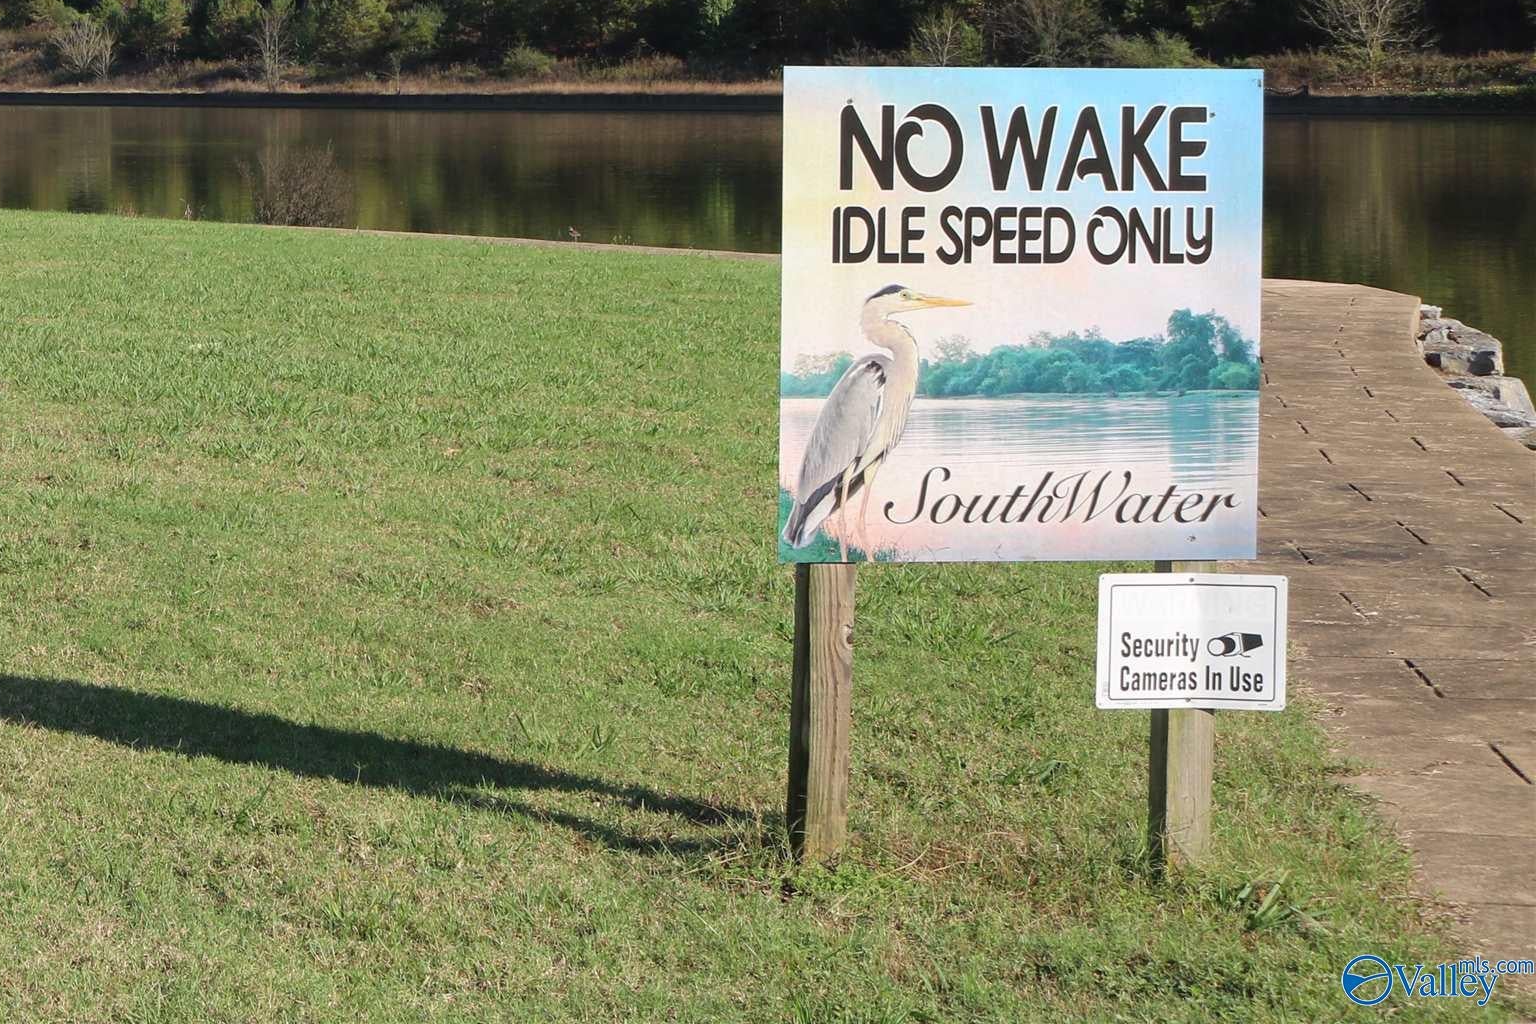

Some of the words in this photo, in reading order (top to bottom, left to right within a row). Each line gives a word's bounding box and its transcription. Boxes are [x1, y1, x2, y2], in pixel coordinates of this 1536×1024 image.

[839, 104, 964, 192] NO
[981, 106, 1208, 191] WAKE
[832, 207, 925, 264] IDLE
[936, 206, 1076, 264] SPEED
[1086, 206, 1214, 265] ONLY
[1121, 632, 1200, 662] Security
[1120, 666, 1197, 692] Cameras
[1205, 666, 1222, 691] In
[1230, 666, 1263, 692] Use
